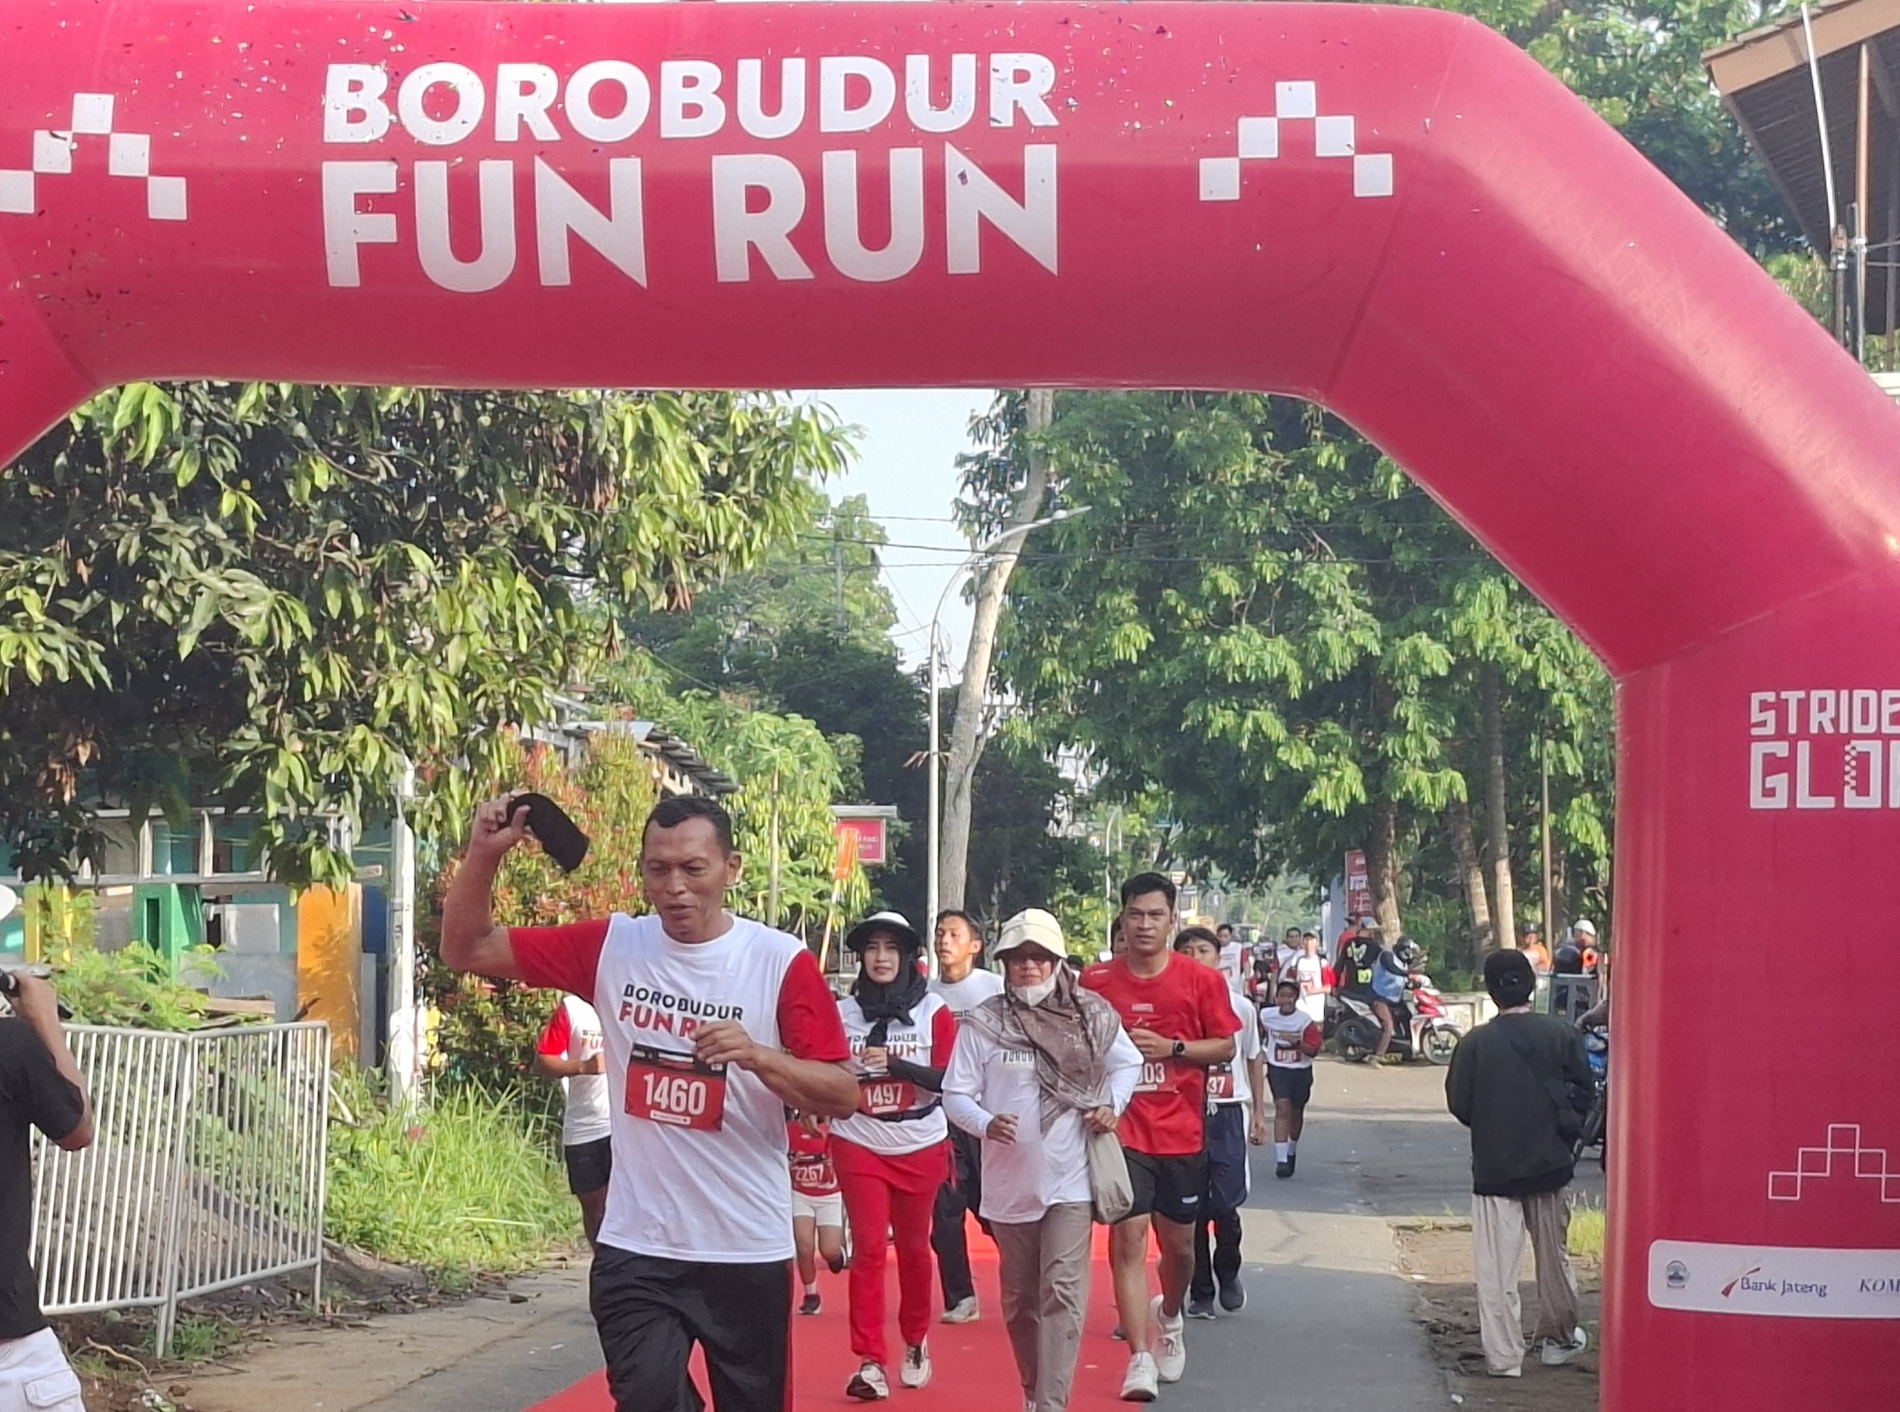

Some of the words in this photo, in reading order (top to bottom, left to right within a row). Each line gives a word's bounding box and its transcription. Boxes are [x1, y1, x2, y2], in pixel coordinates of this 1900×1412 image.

[322, 52, 1059, 146] BOROBUDUR
[322, 155, 648, 293] FUN
[711, 141, 1059, 284] RUN
[1750, 689, 1900, 735] STRIDE
[619, 1001, 675, 1036] FUN
[623, 984, 744, 1020] BOROBUDUR
[1136, 1062, 1166, 1084] 03
[643, 1072, 707, 1115] 1460
[864, 1083, 903, 1107] 1497
[1741, 1276, 1777, 1291] Bank
[1780, 1279, 1827, 1297] Jateng
